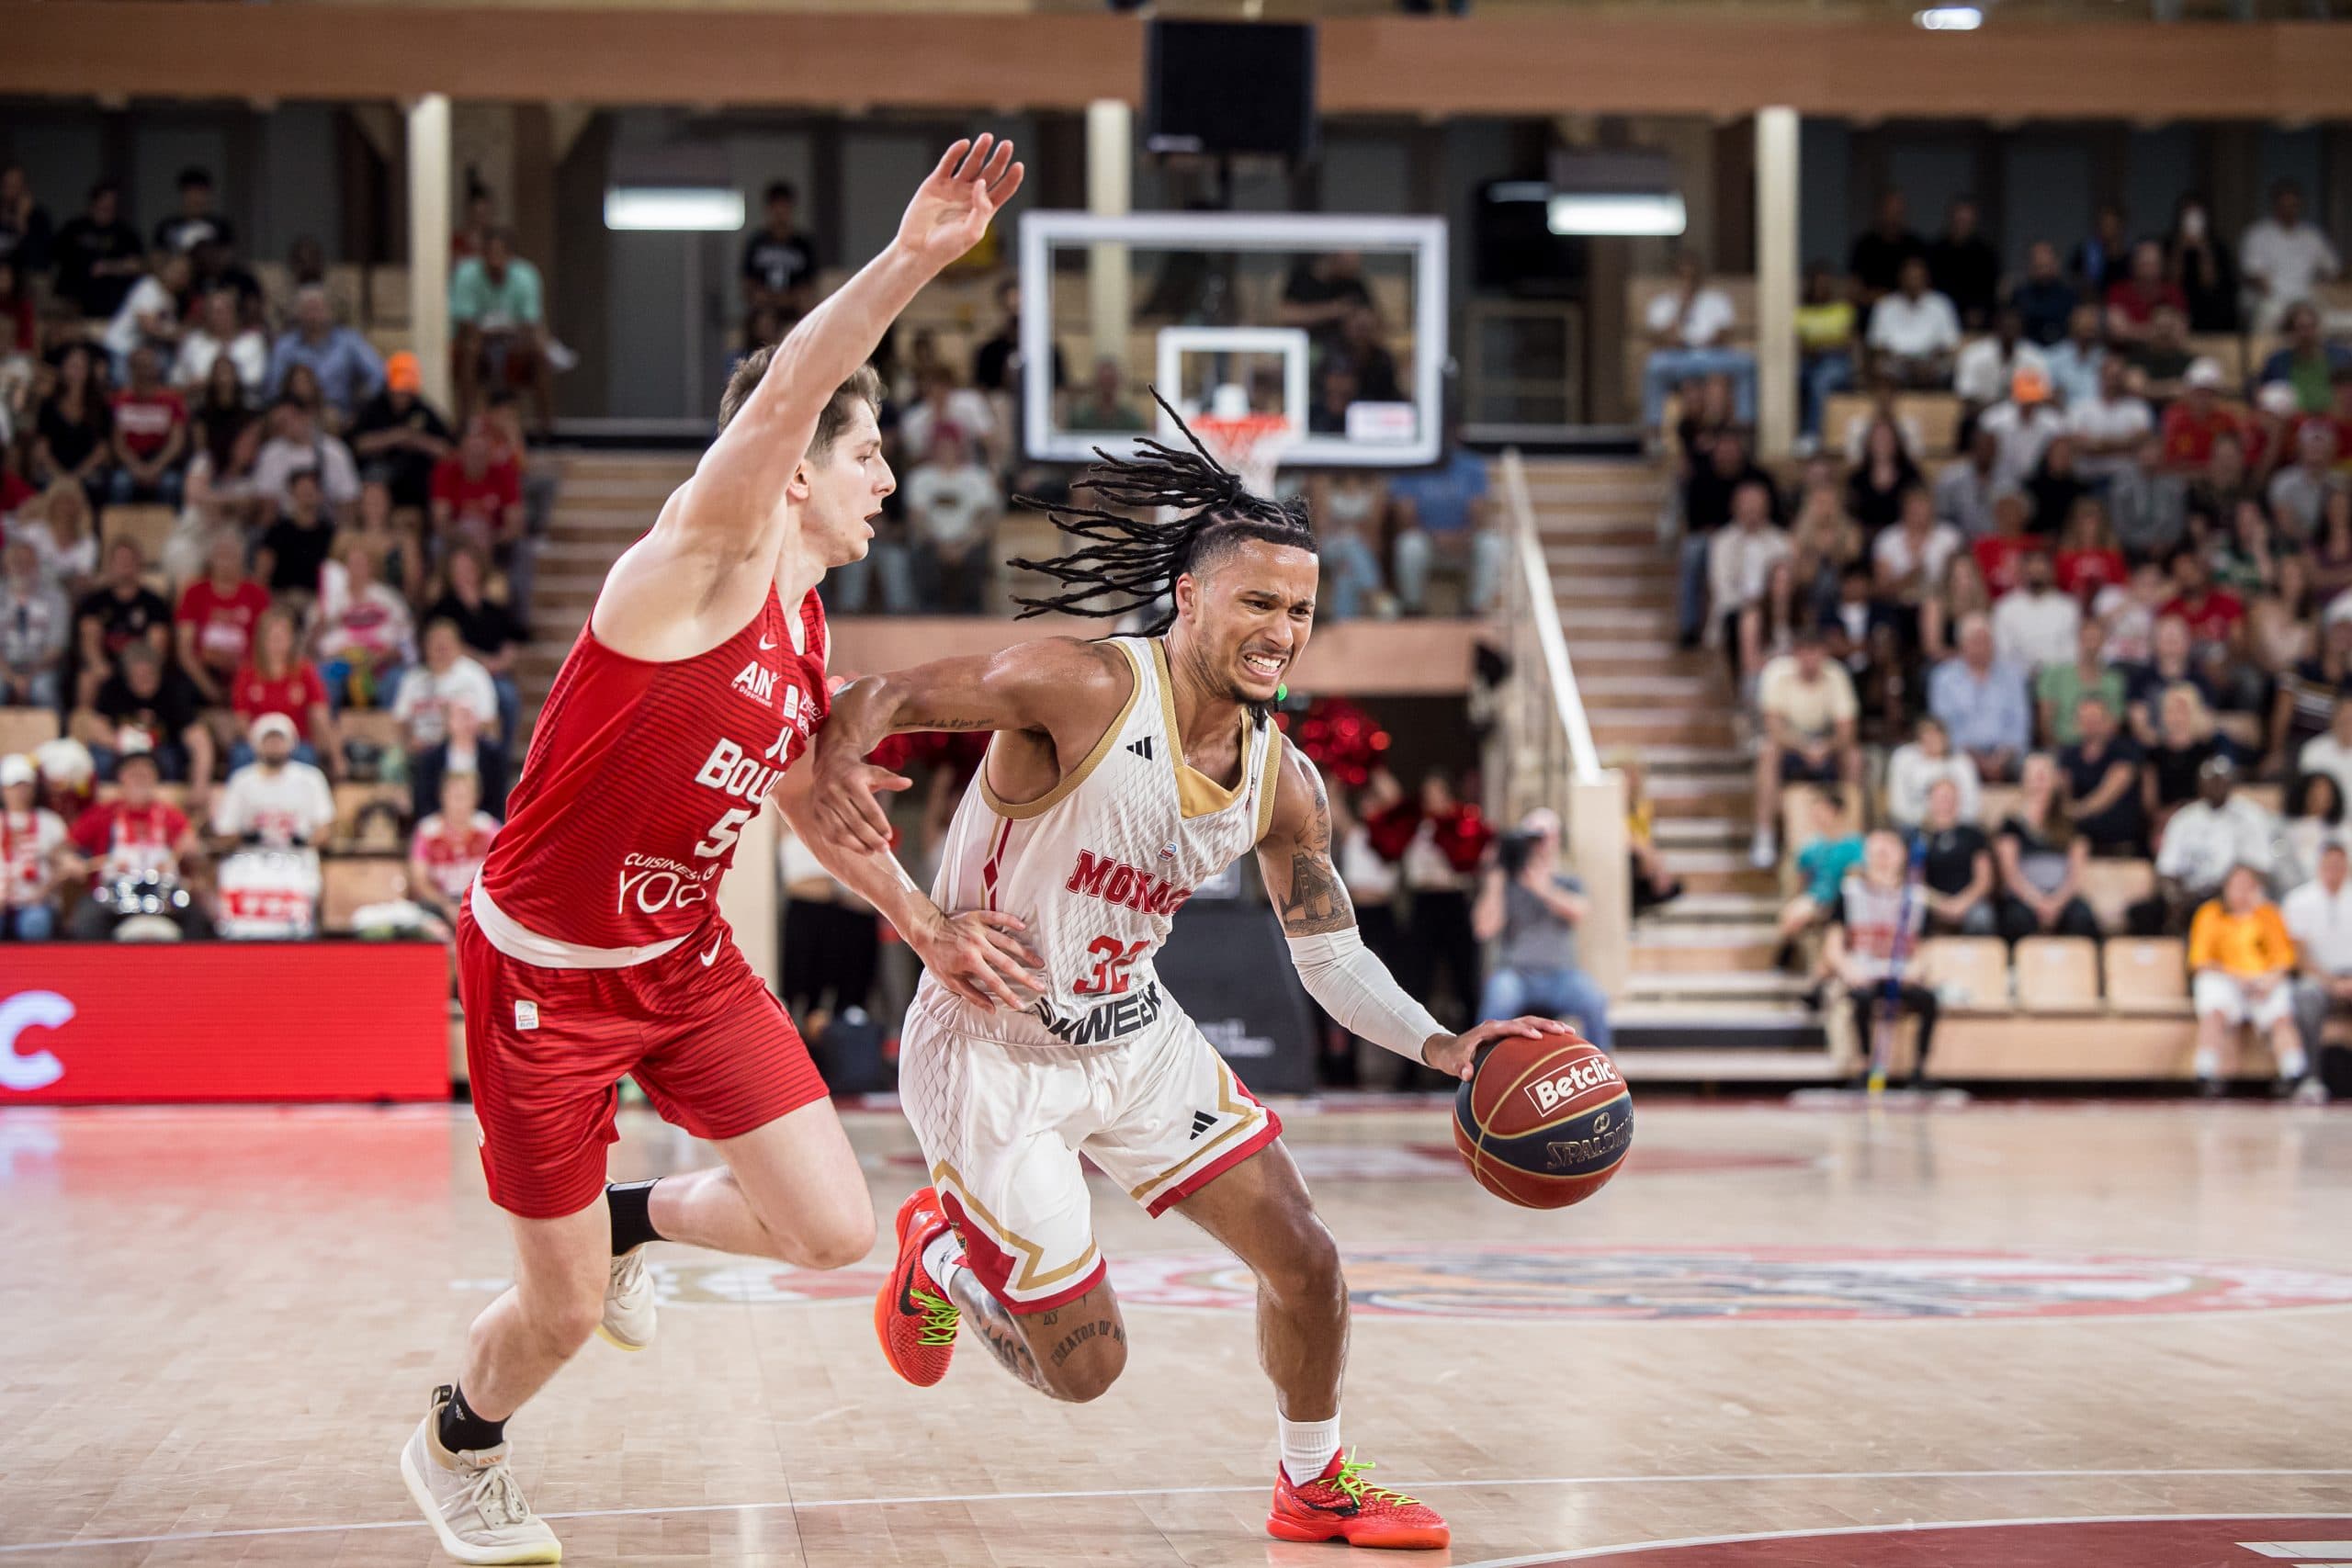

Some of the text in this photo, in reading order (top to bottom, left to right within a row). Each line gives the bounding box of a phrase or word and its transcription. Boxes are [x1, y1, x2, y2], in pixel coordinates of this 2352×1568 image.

[695, 737, 786, 805] BOU
[694, 807, 752, 858] 5
[1072, 934, 1150, 995] 32
[1535, 1057, 1616, 1111] Betclic
